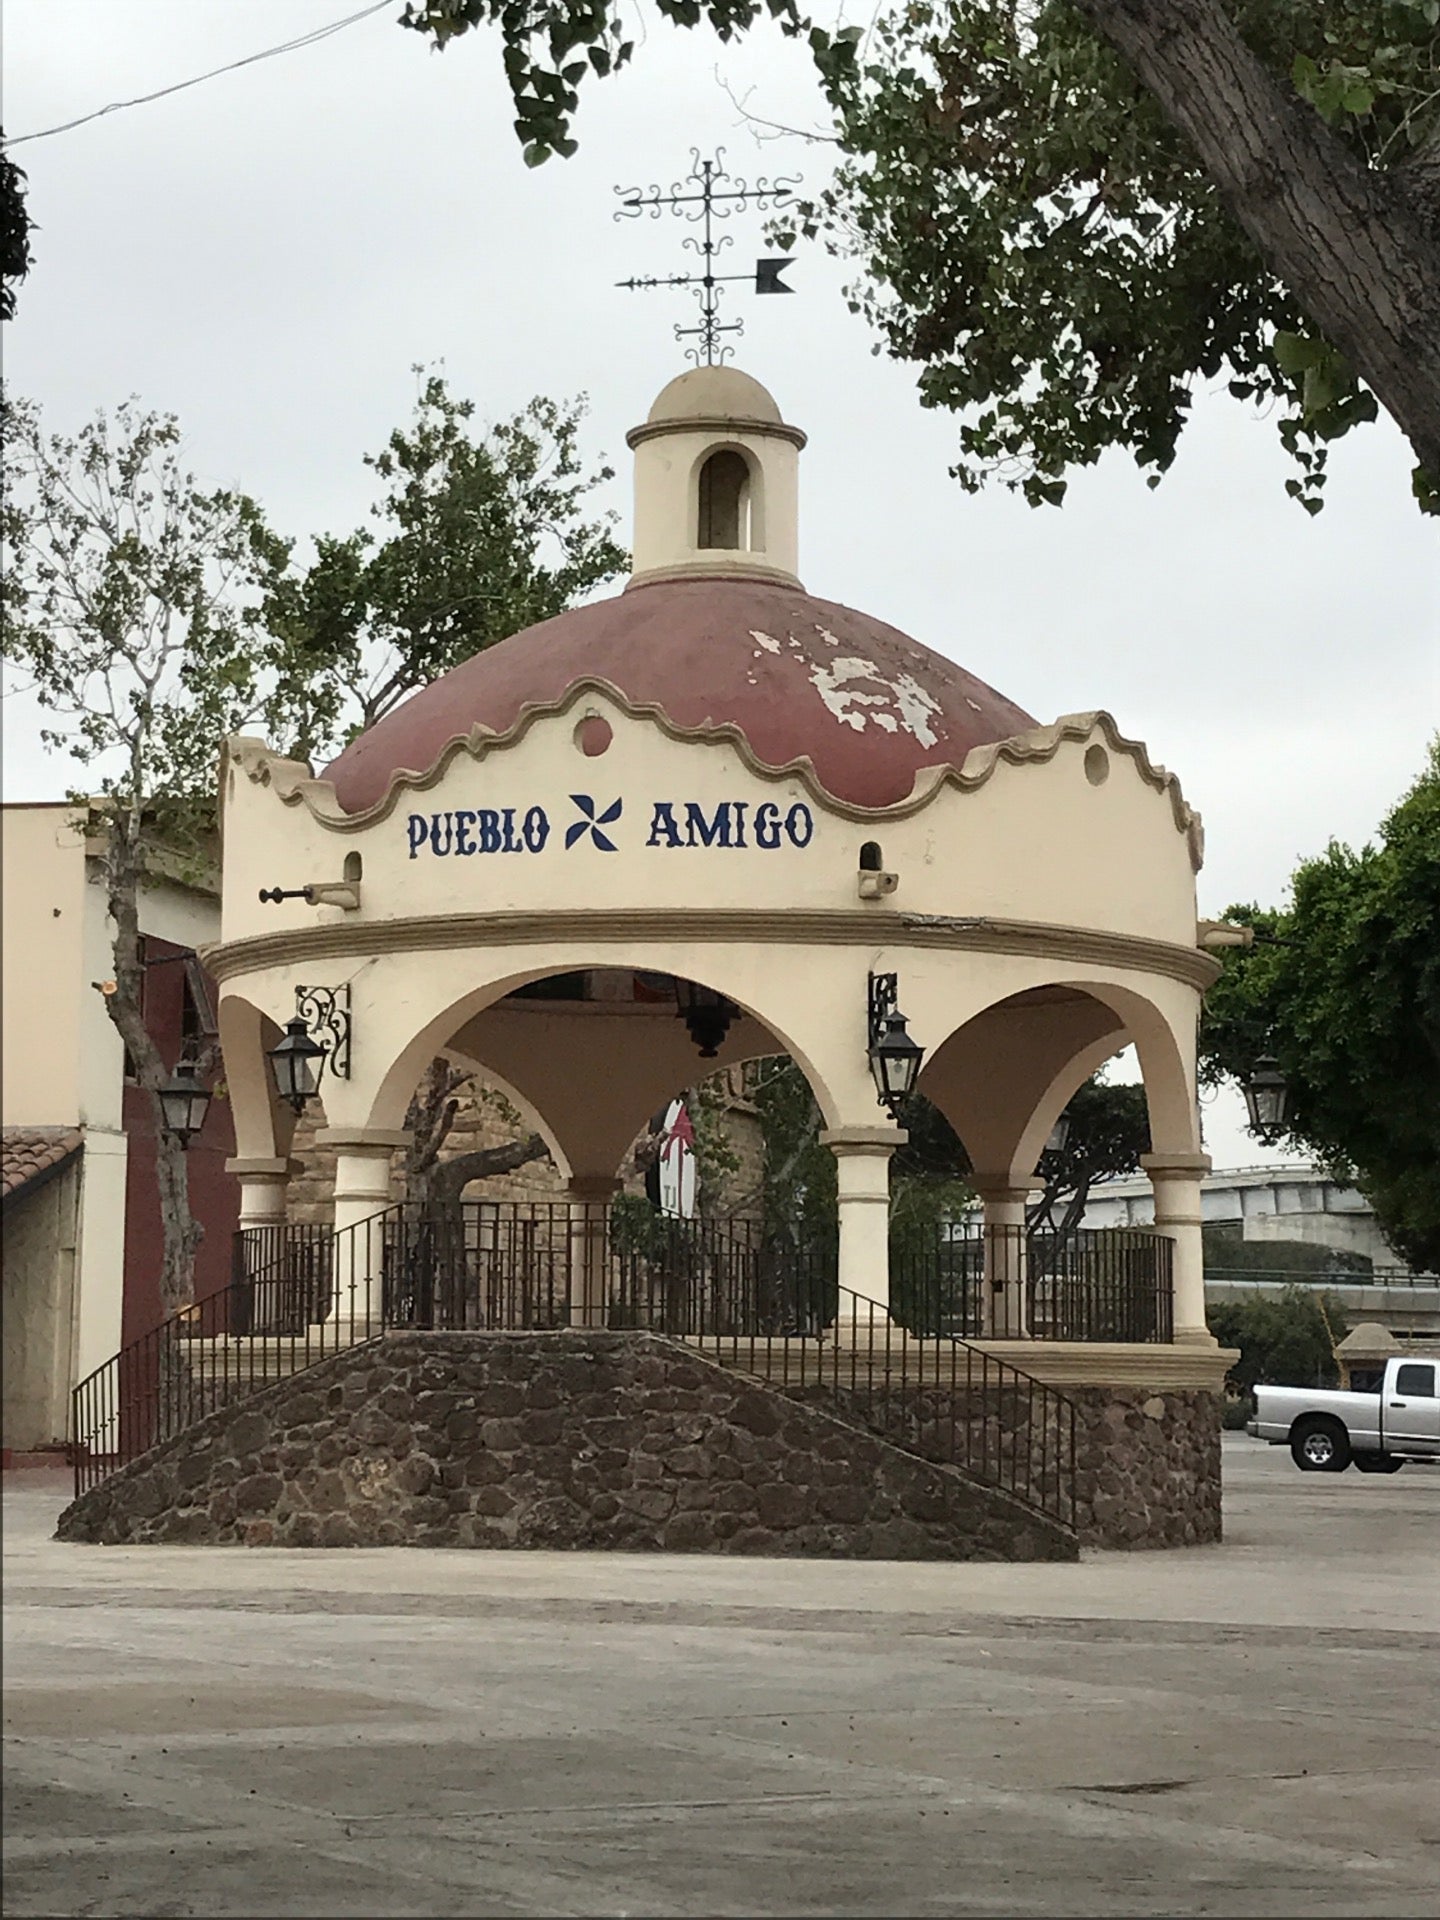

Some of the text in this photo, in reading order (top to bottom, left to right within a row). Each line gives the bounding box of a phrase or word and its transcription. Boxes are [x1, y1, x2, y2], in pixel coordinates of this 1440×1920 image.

[407, 801, 815, 860] PUEBLO AMIGO
[663, 1184, 677, 1209] TJ
